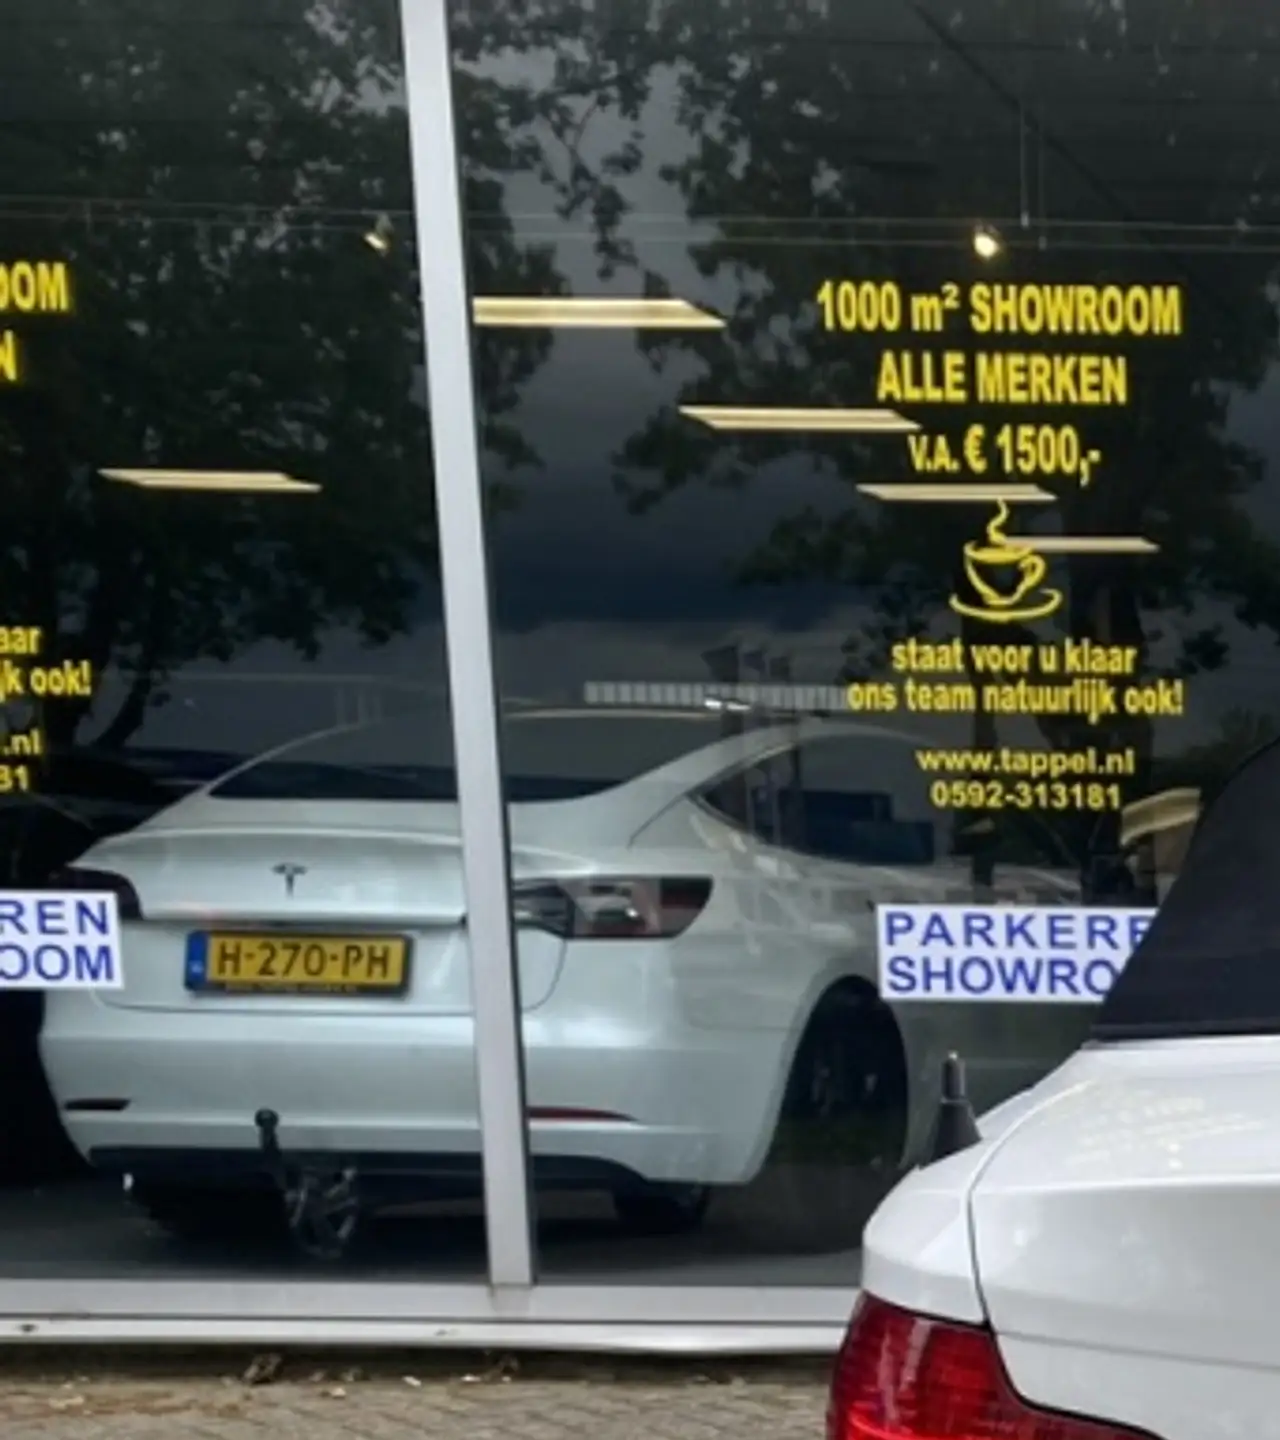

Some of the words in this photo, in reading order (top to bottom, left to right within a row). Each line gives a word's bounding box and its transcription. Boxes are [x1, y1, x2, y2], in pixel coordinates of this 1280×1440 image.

[816, 280, 901, 331] 1000
[911, 283, 960, 331] m²
[970, 284, 1181, 335] SHOWROOM
[877, 352, 966, 401] ALLE
[976, 354, 1127, 404] MERKEN
[964, 424, 987, 472] €
[997, 424, 1101, 486] 1500,-
[892, 638, 965, 671] staat
[971, 643, 1032, 672] voor
[1040, 645, 1057, 672] u
[1064, 639, 1137, 673] klaar
[30, 659, 91, 695] ook!
[847, 682, 898, 710] ons
[905, 680, 975, 711] team
[983, 679, 1118, 724] natuurlijk
[1124, 682, 1184, 715] ook!
[916, 748, 1135, 777] www.tappel.nl
[930, 782, 1120, 811] 0592-313181
[217, 941, 390, 978] H-270-PH
